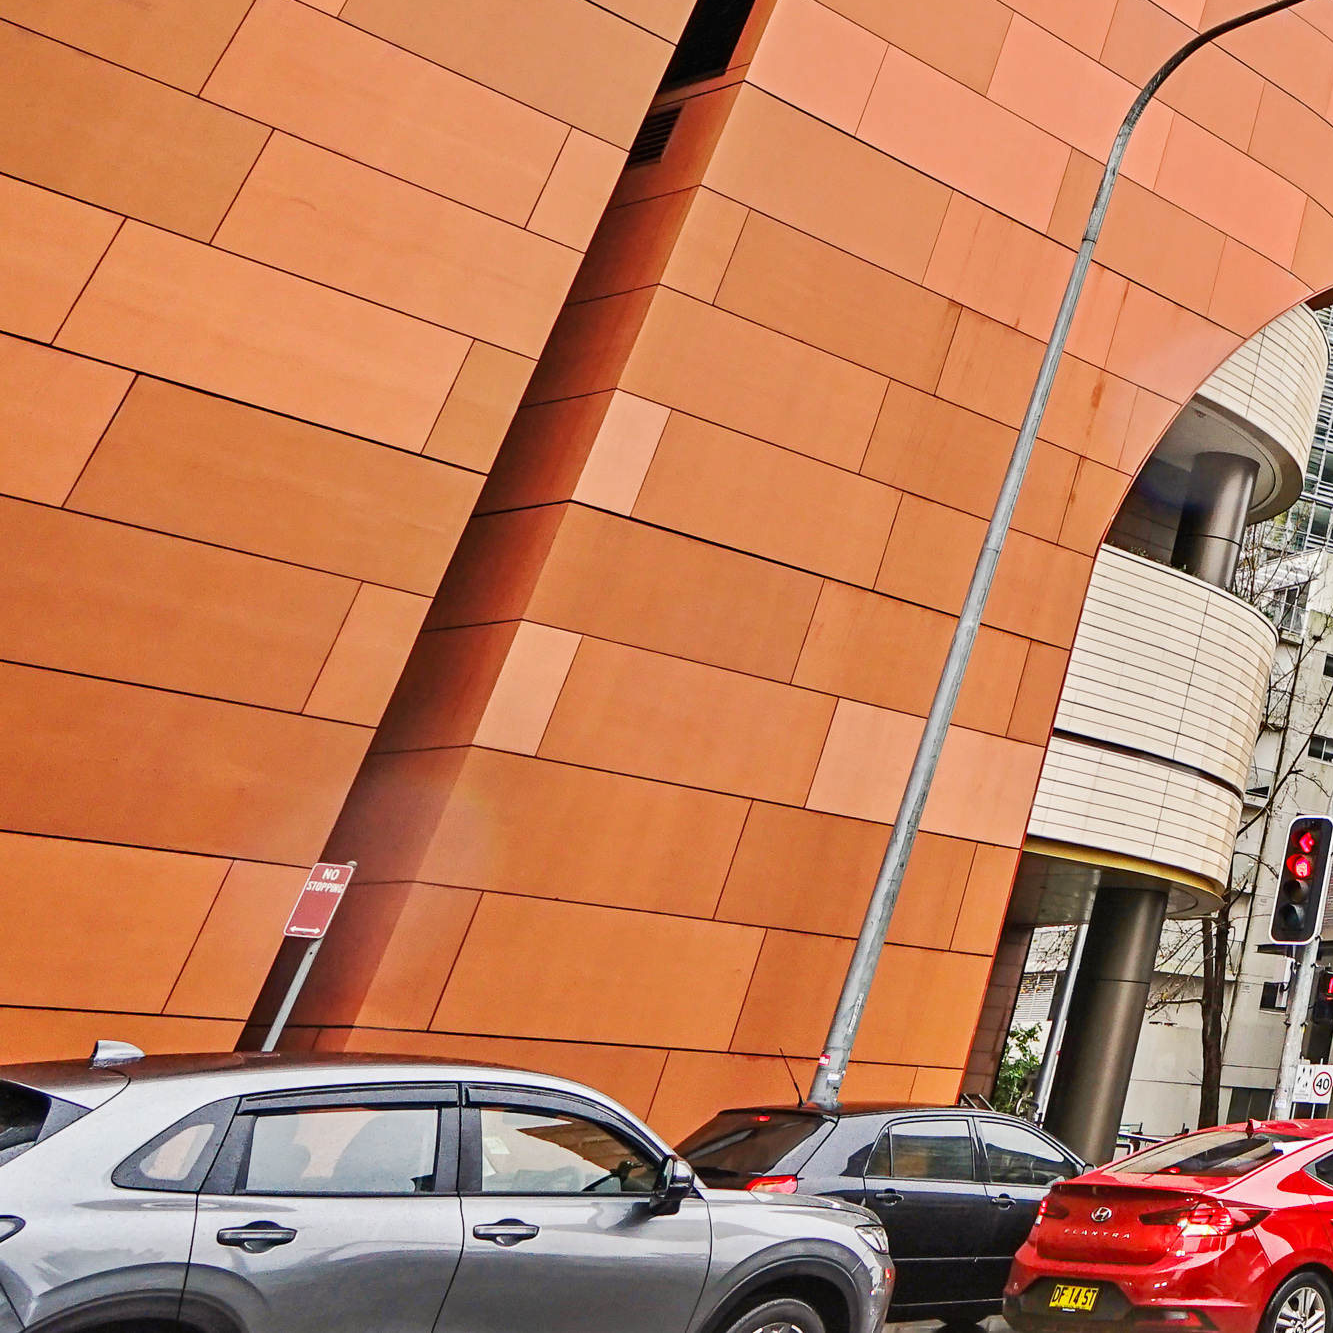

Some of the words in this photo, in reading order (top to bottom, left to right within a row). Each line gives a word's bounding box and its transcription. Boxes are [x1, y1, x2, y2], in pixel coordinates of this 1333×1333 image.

[322, 868, 340, 881] NO
[306, 881, 345, 894] STOPPING
[1315, 1078, 1330, 1090] 40
[1064, 1228, 1131, 1239] ELANTRA
